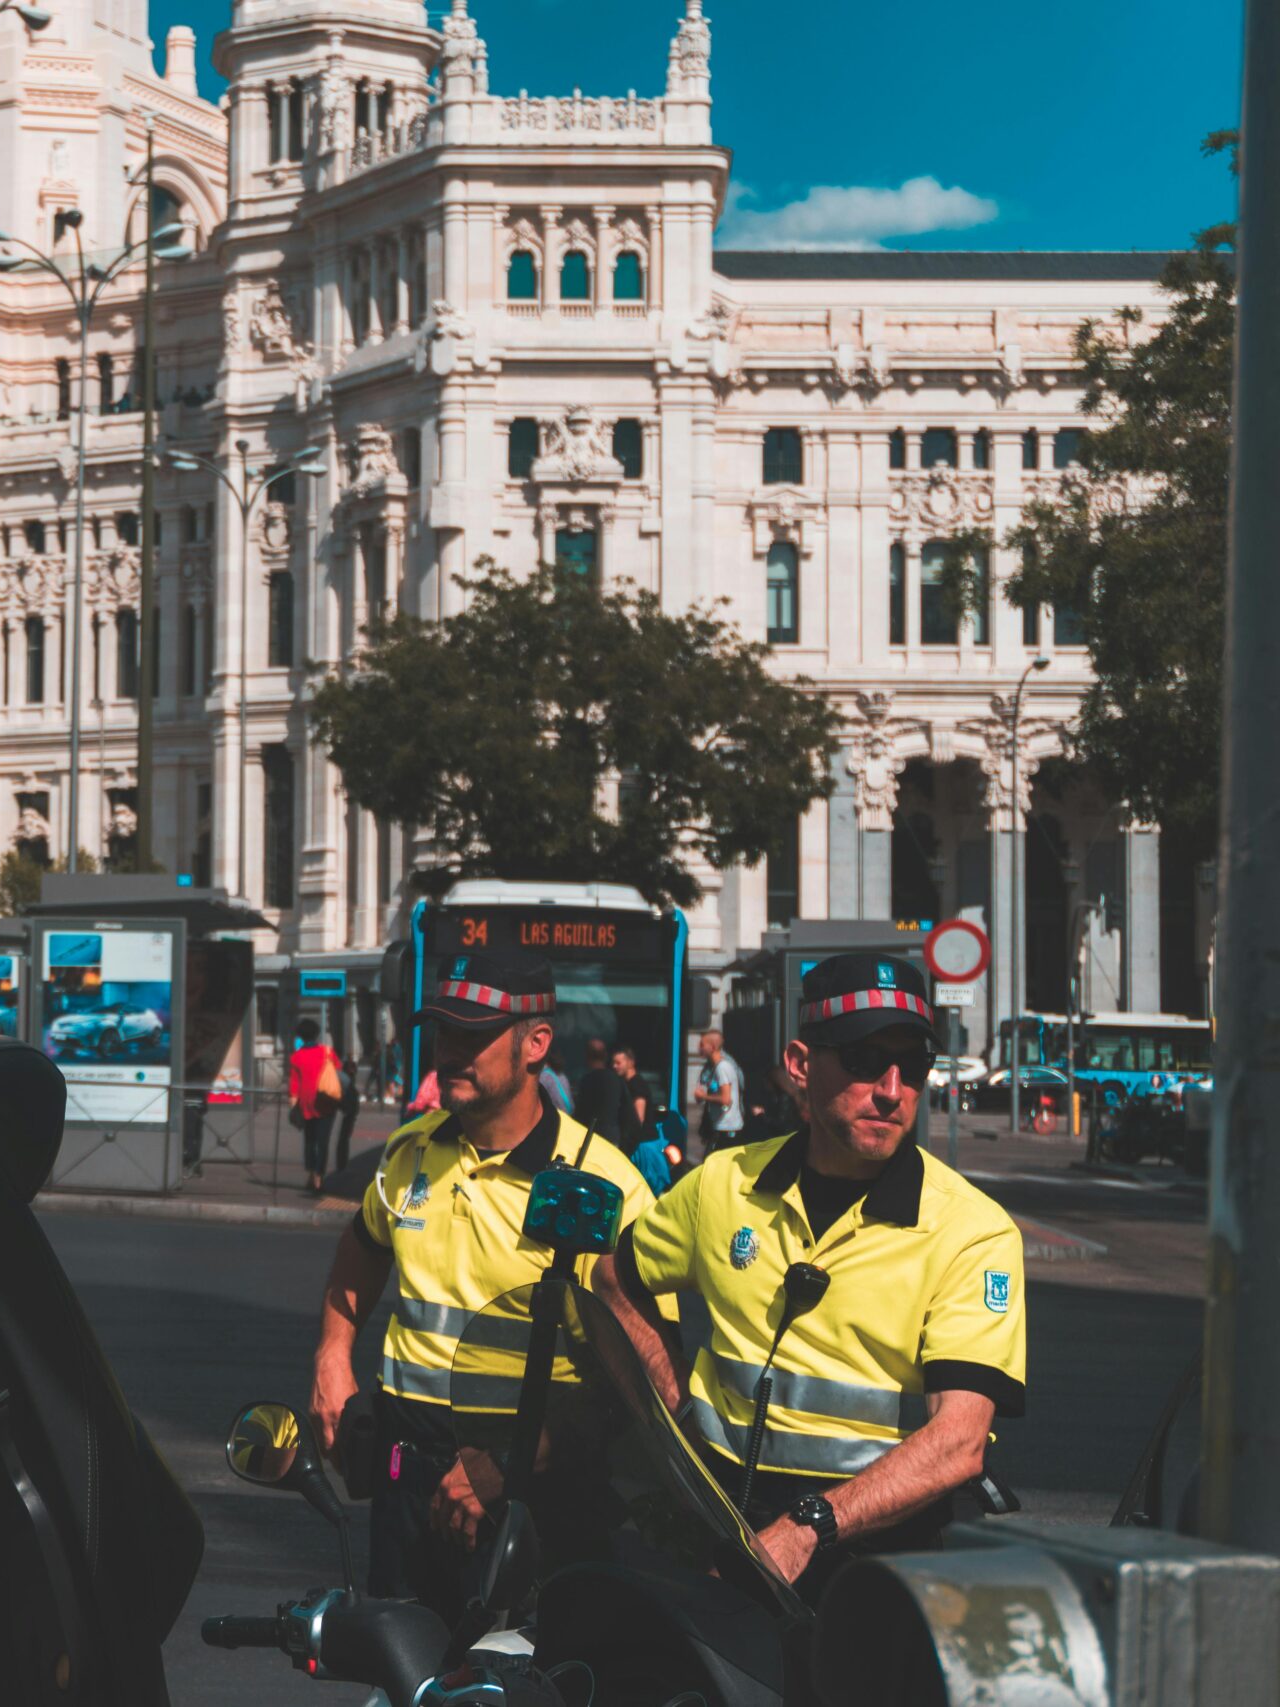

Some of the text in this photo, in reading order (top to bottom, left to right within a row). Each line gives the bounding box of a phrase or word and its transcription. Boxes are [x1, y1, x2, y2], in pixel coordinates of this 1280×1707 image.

[462, 918, 616, 947] 34 LAS AGUILAS
